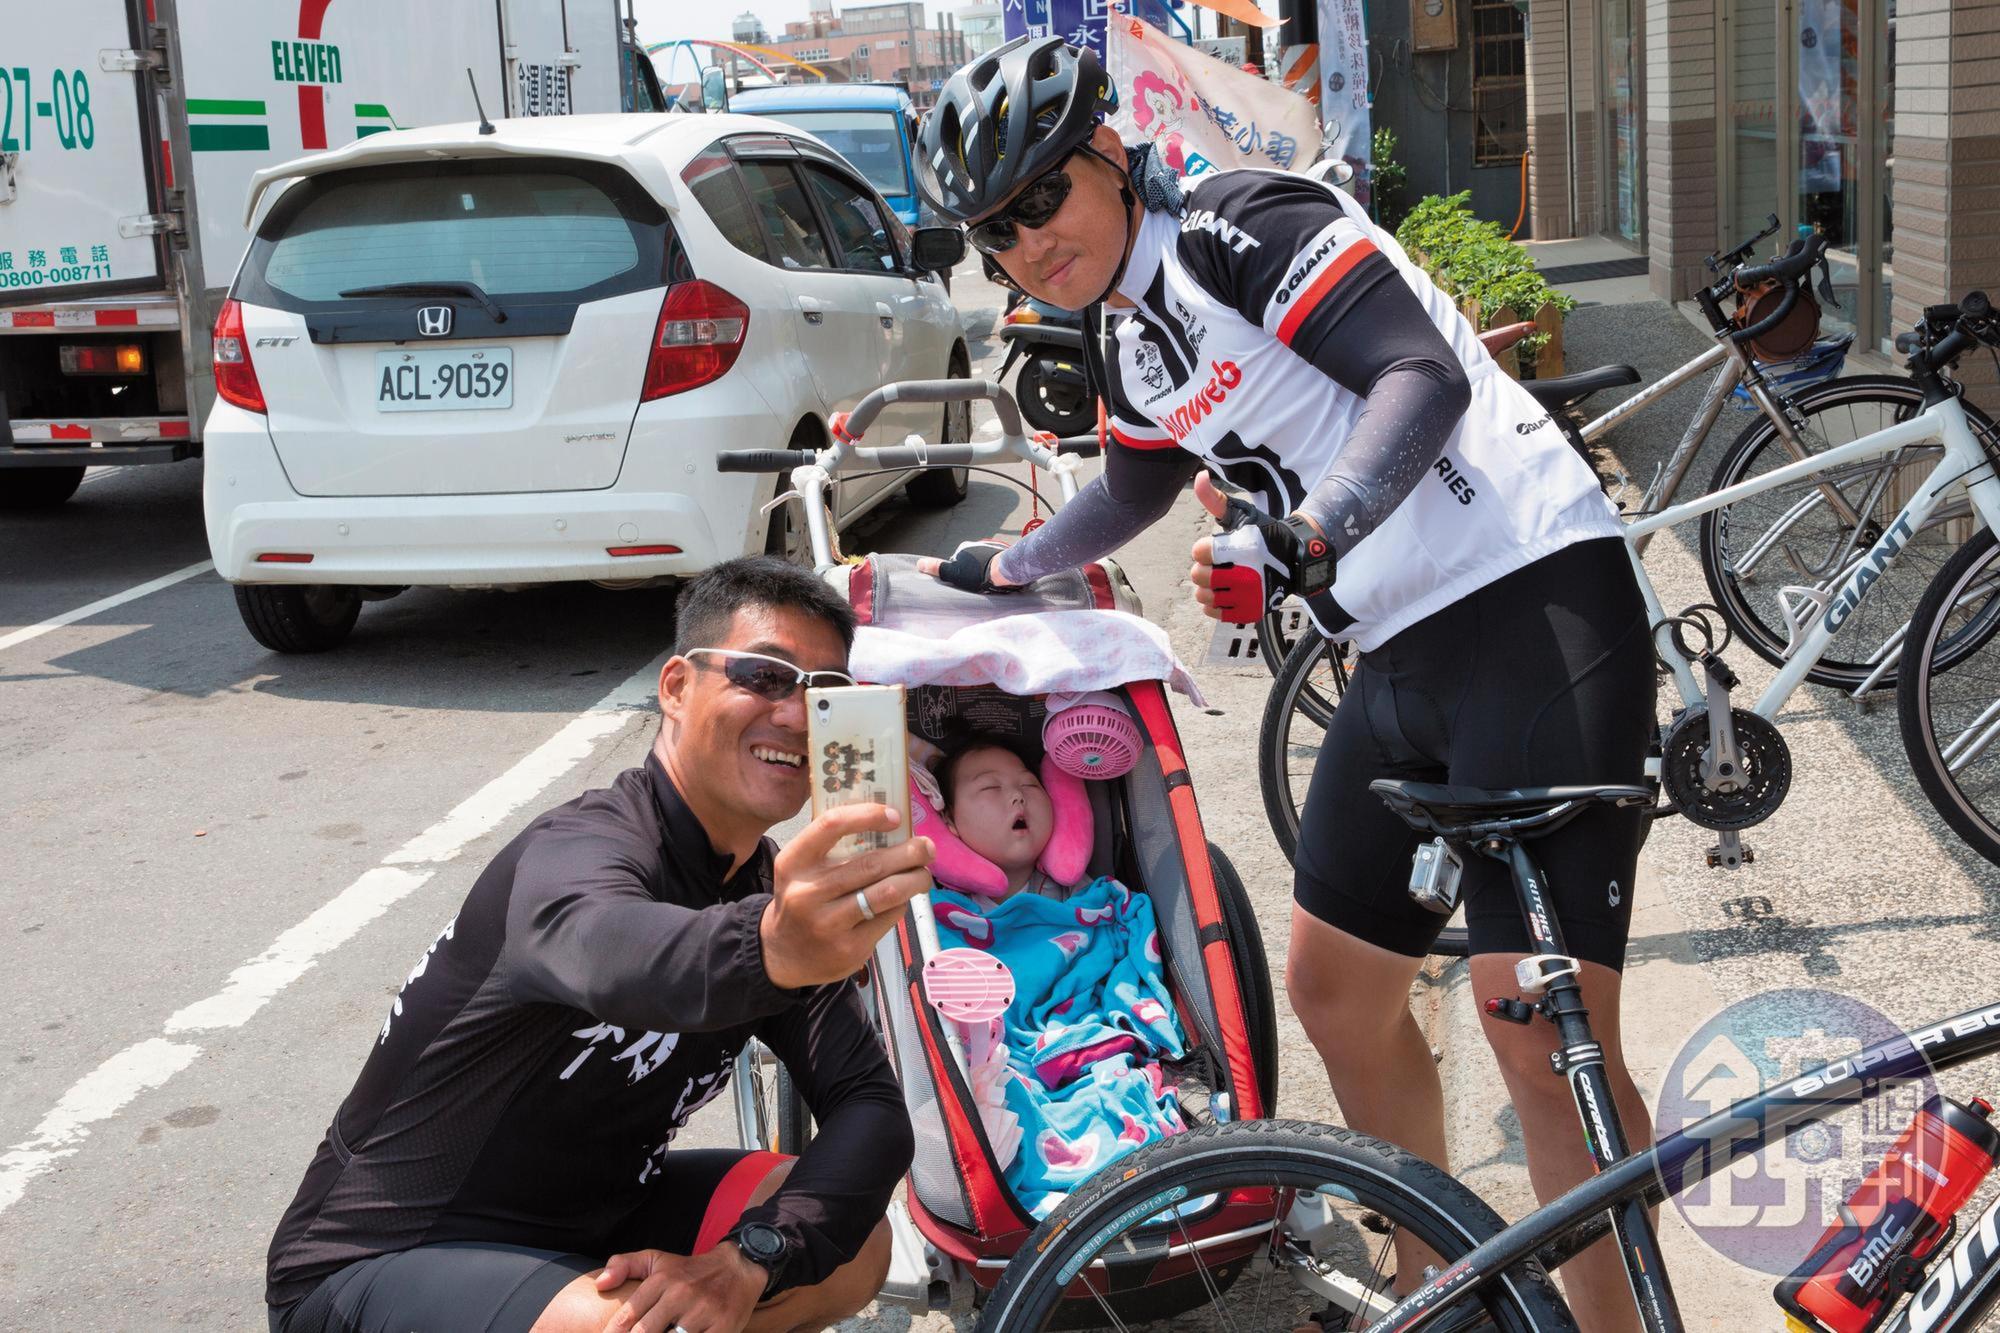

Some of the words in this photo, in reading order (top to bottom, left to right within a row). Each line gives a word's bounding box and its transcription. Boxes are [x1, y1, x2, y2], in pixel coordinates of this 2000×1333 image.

[0, 264, 112, 288] 0800-008711
[1287, 235, 1338, 291] GIANT
[1823, 511, 1915, 635] GIANT
[1527, 878, 1555, 947] RITCHEY
[1792, 1028, 1946, 1097] SUPER
[1067, 1190, 1102, 1219] Country
[1847, 1214, 1905, 1288] BMC
